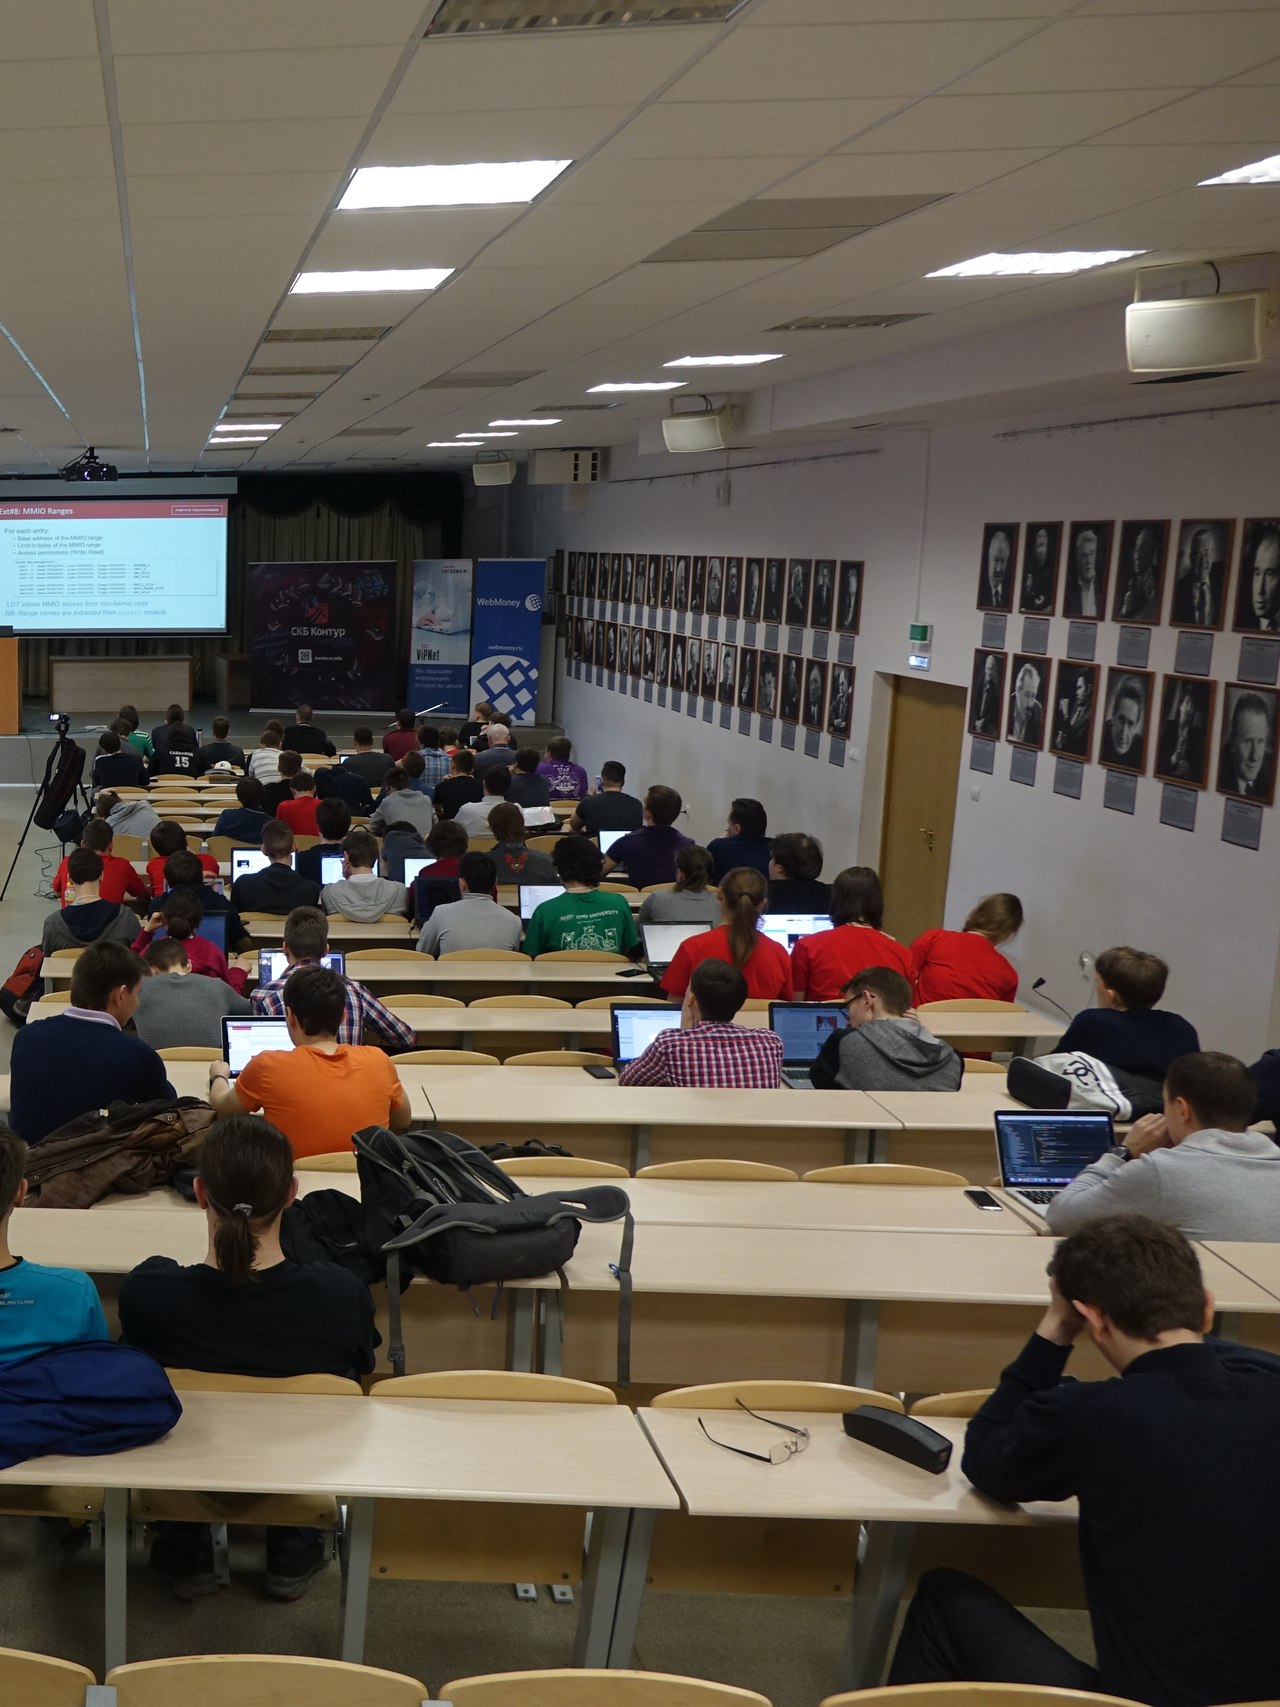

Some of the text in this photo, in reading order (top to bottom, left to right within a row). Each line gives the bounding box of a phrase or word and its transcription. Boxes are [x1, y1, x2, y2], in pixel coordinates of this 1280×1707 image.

[47, 507, 73, 516] Ranges
[477, 598, 521, 608] WebMoney
[291, 626, 346, 638] СКБ Контур
[174, 756, 190, 768] 15
[589, 909, 619, 918] UNIVERSITY
